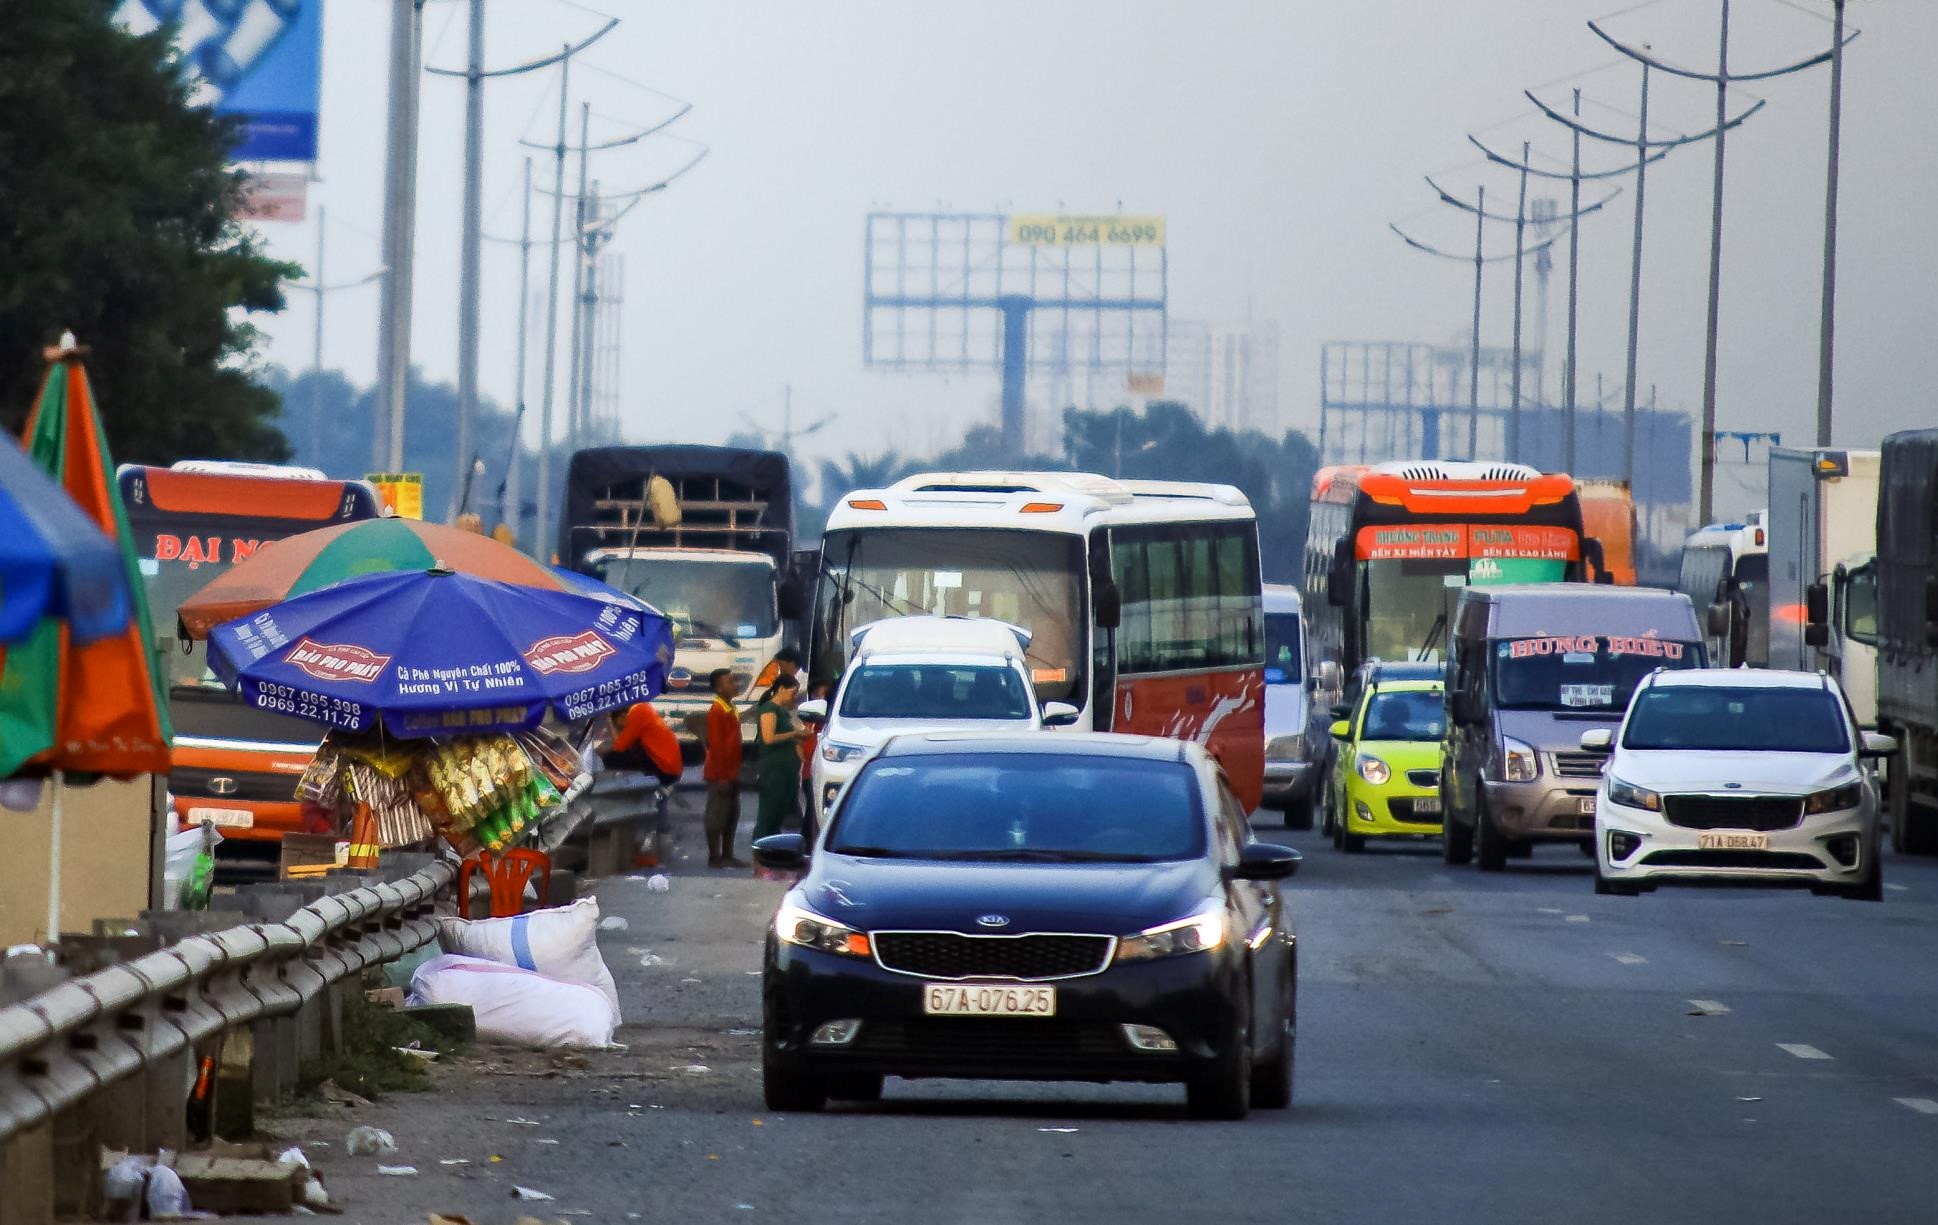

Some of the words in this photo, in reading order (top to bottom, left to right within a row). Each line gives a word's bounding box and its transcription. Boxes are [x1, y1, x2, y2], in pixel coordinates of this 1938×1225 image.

[1019, 224, 1056, 242] 090
[1064, 226, 1099, 242] 464
[1108, 225, 1156, 242] 6699
[155, 534, 222, 570] ĐẠI
[1394, 547, 1407, 557] XE
[1504, 548, 1517, 557] XE
[1519, 549, 1540, 557] CAO
[319, 655, 348, 670] PRO
[413, 668, 430, 681] Phê
[433, 667, 467, 681] Nguyên
[495, 659, 521, 675] 100%
[399, 682, 440, 694] Hương
[445, 680, 459, 693] Vị
[463, 679, 480, 692] Tự
[485, 676, 524, 689] Nhiên
[257, 693, 360, 729] 0969.22.11.76
[980, 914, 1006, 925] KIA
[931, 988, 1049, 1013] 67A-076.25
